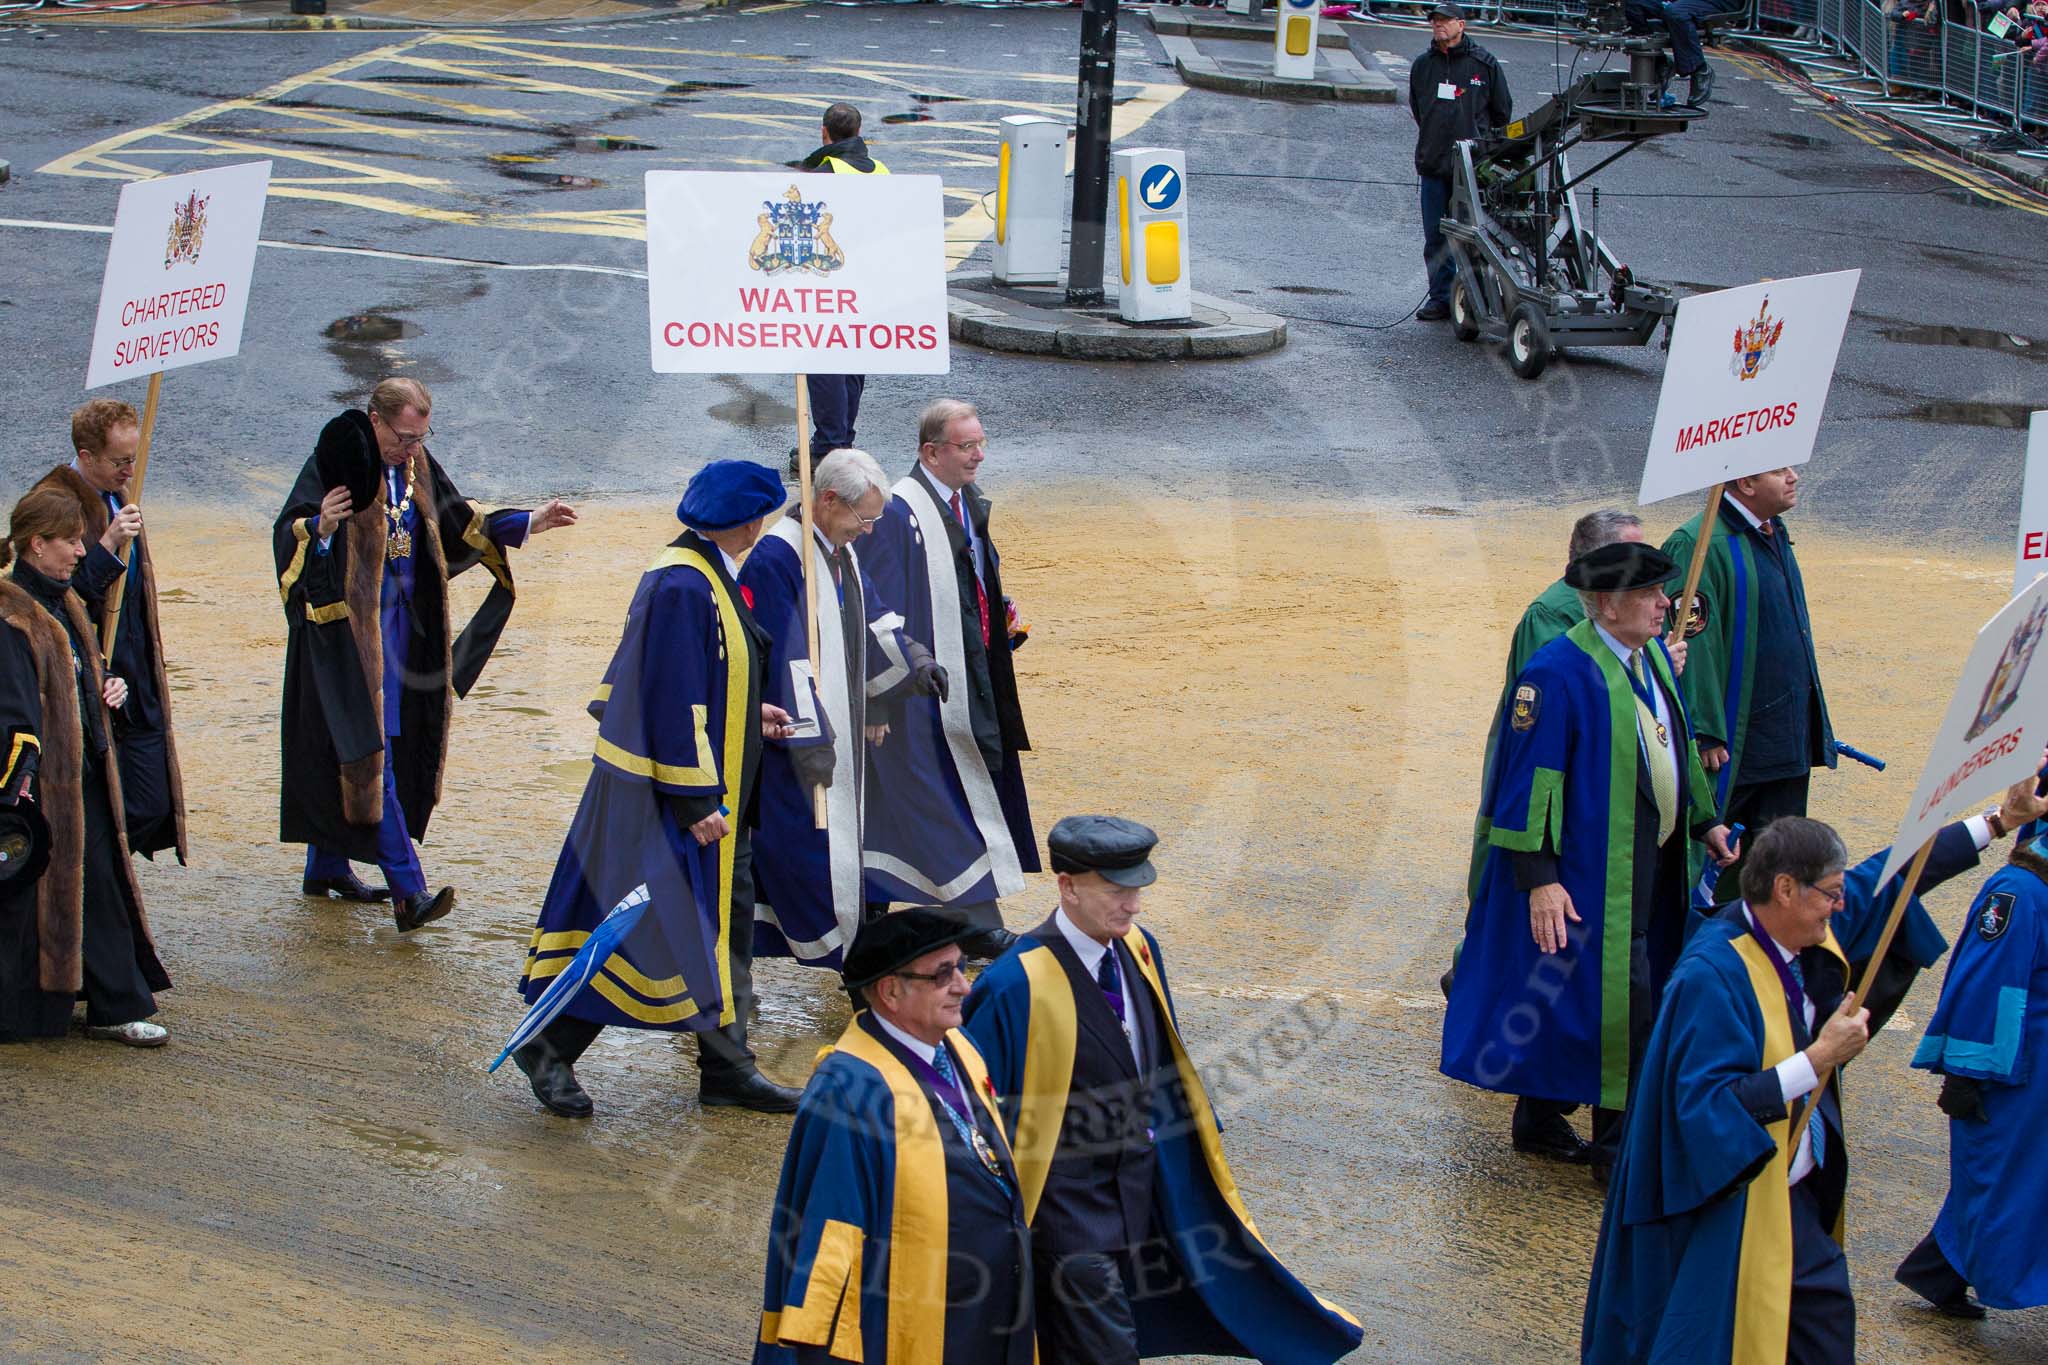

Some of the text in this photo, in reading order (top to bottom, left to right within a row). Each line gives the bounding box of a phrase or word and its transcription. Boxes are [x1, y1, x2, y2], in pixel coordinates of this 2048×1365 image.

[121, 282, 225, 327] CHARTERED
[739, 287, 858, 314] WATER
[113, 321, 219, 367] SURVEYORS
[664, 322, 938, 351] CONSERVATORS
[1676, 401, 1799, 452] MARKETORS
[2023, 531, 2048, 560] E
[1917, 727, 2023, 821] LAUNDERERS
